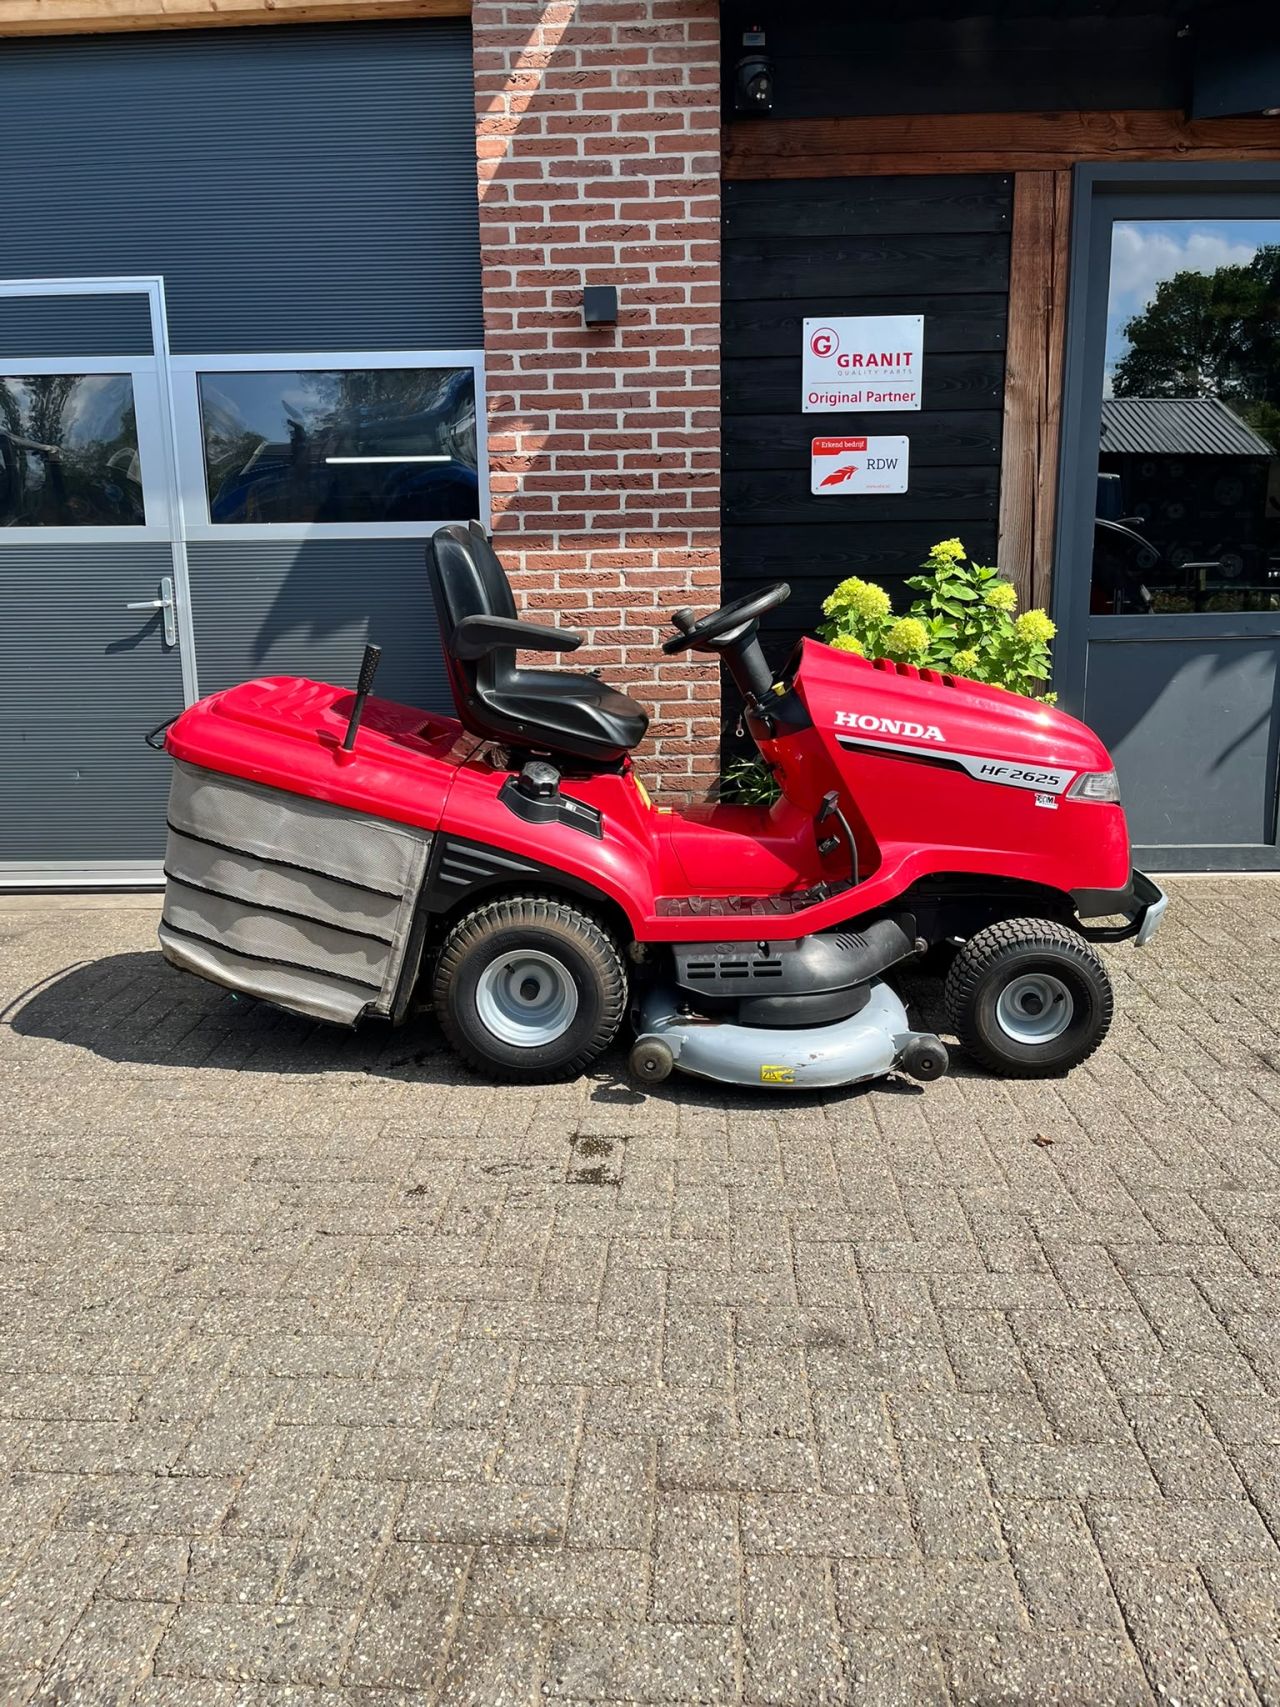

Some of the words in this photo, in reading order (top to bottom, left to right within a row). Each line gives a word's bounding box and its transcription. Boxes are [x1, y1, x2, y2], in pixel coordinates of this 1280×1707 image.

[812, 335, 832, 355] G
[837, 352, 913, 368] GRANIT
[808, 391, 862, 407] Original
[866, 391, 916, 403] Partner
[821, 441, 843, 449] Erkend
[844, 440, 865, 449] bedrijf
[866, 458, 898, 470] RDW
[834, 710, 946, 742] HONDA
[980, 764, 1009, 776] HF
[1009, 769, 1061, 785] 2625
